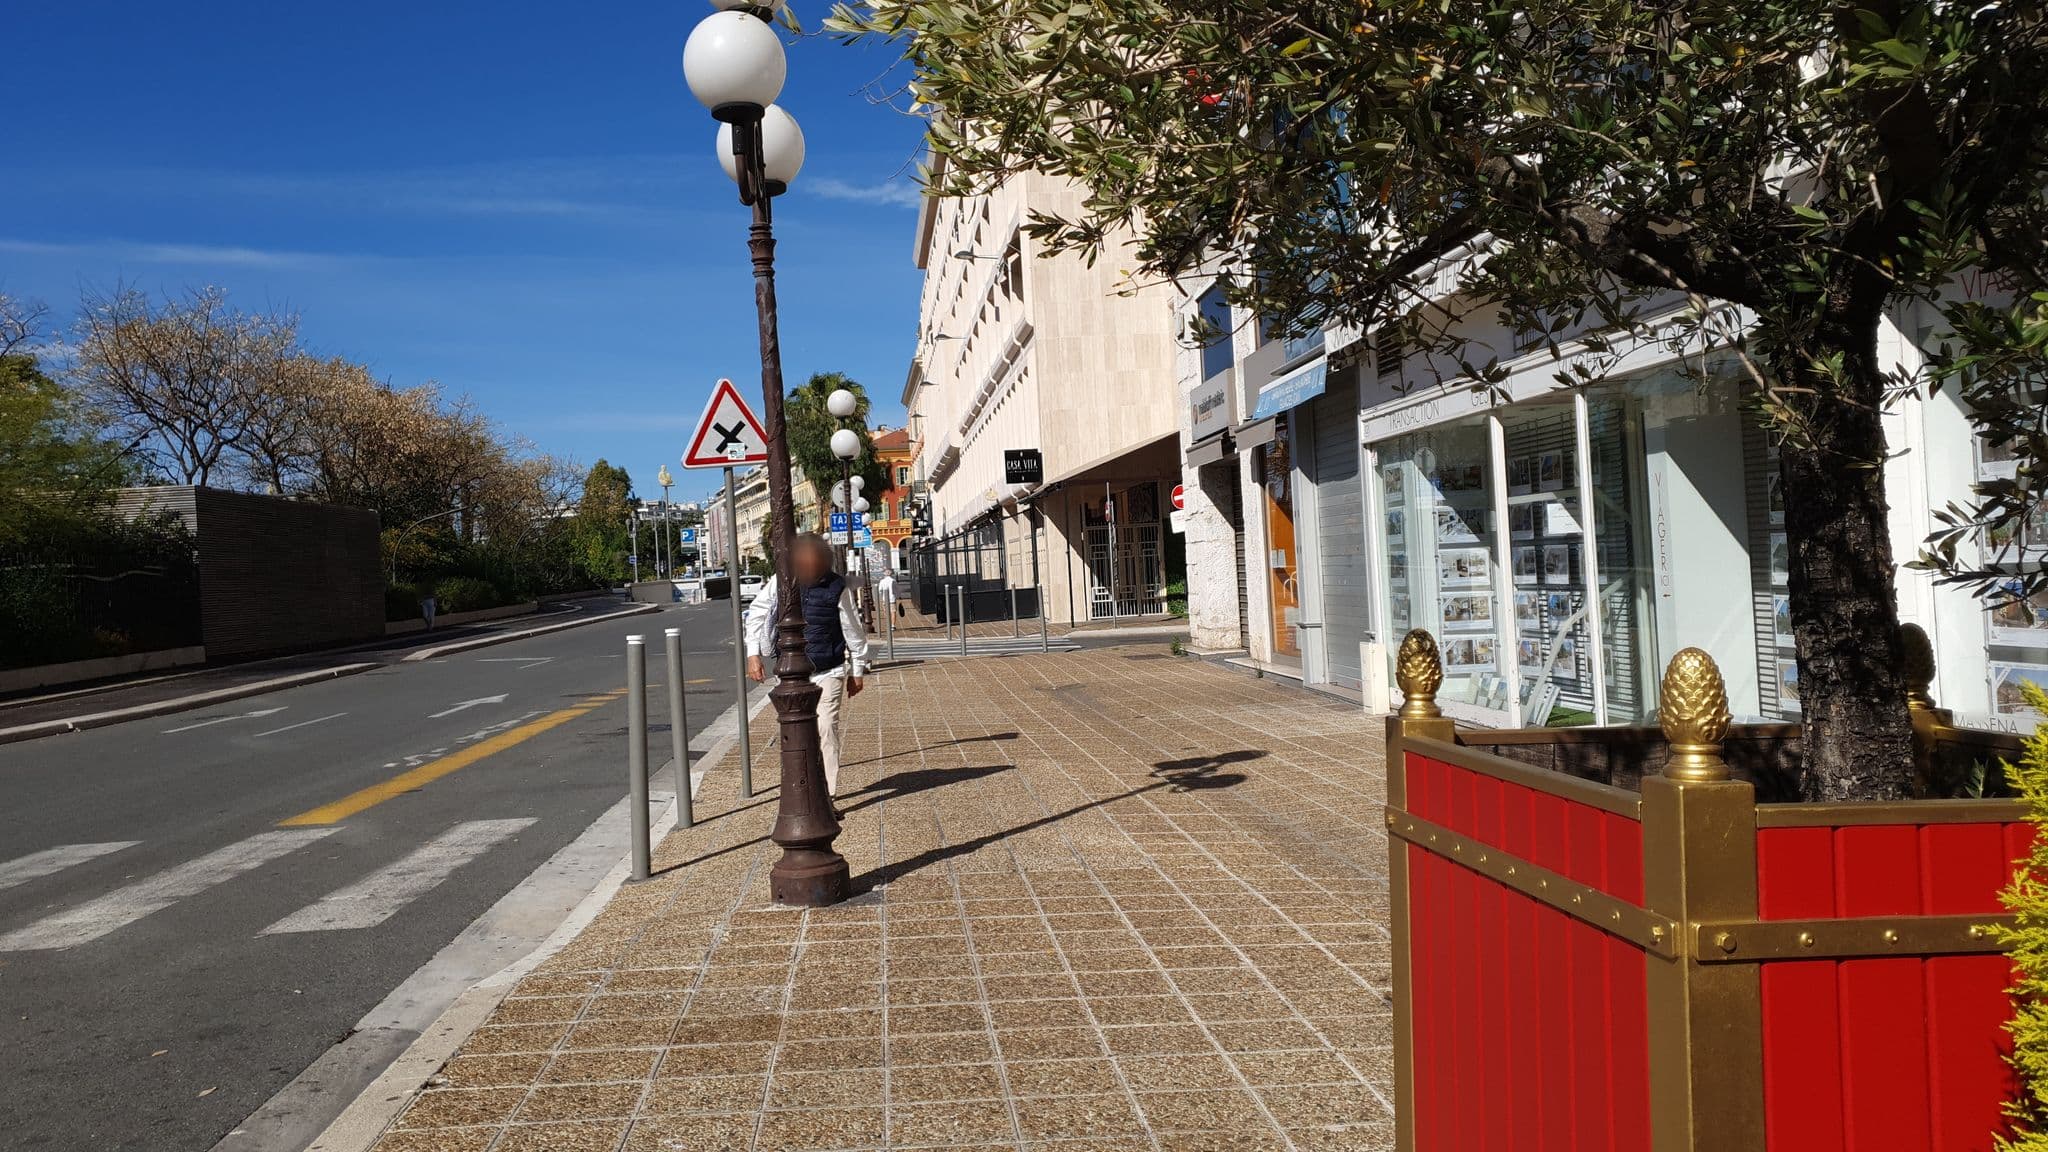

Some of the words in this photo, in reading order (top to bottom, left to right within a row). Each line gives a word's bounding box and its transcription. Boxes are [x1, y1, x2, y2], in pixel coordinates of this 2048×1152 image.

[1387, 400, 1440, 431] TRANSACTION
[1471, 376, 1513, 406] GESON
[1006, 459, 1022, 470] CASA
[1023, 458, 1038, 470] VITA
[831, 514, 861, 525] TAXS
[1654, 471, 1668, 572] VIAGER
